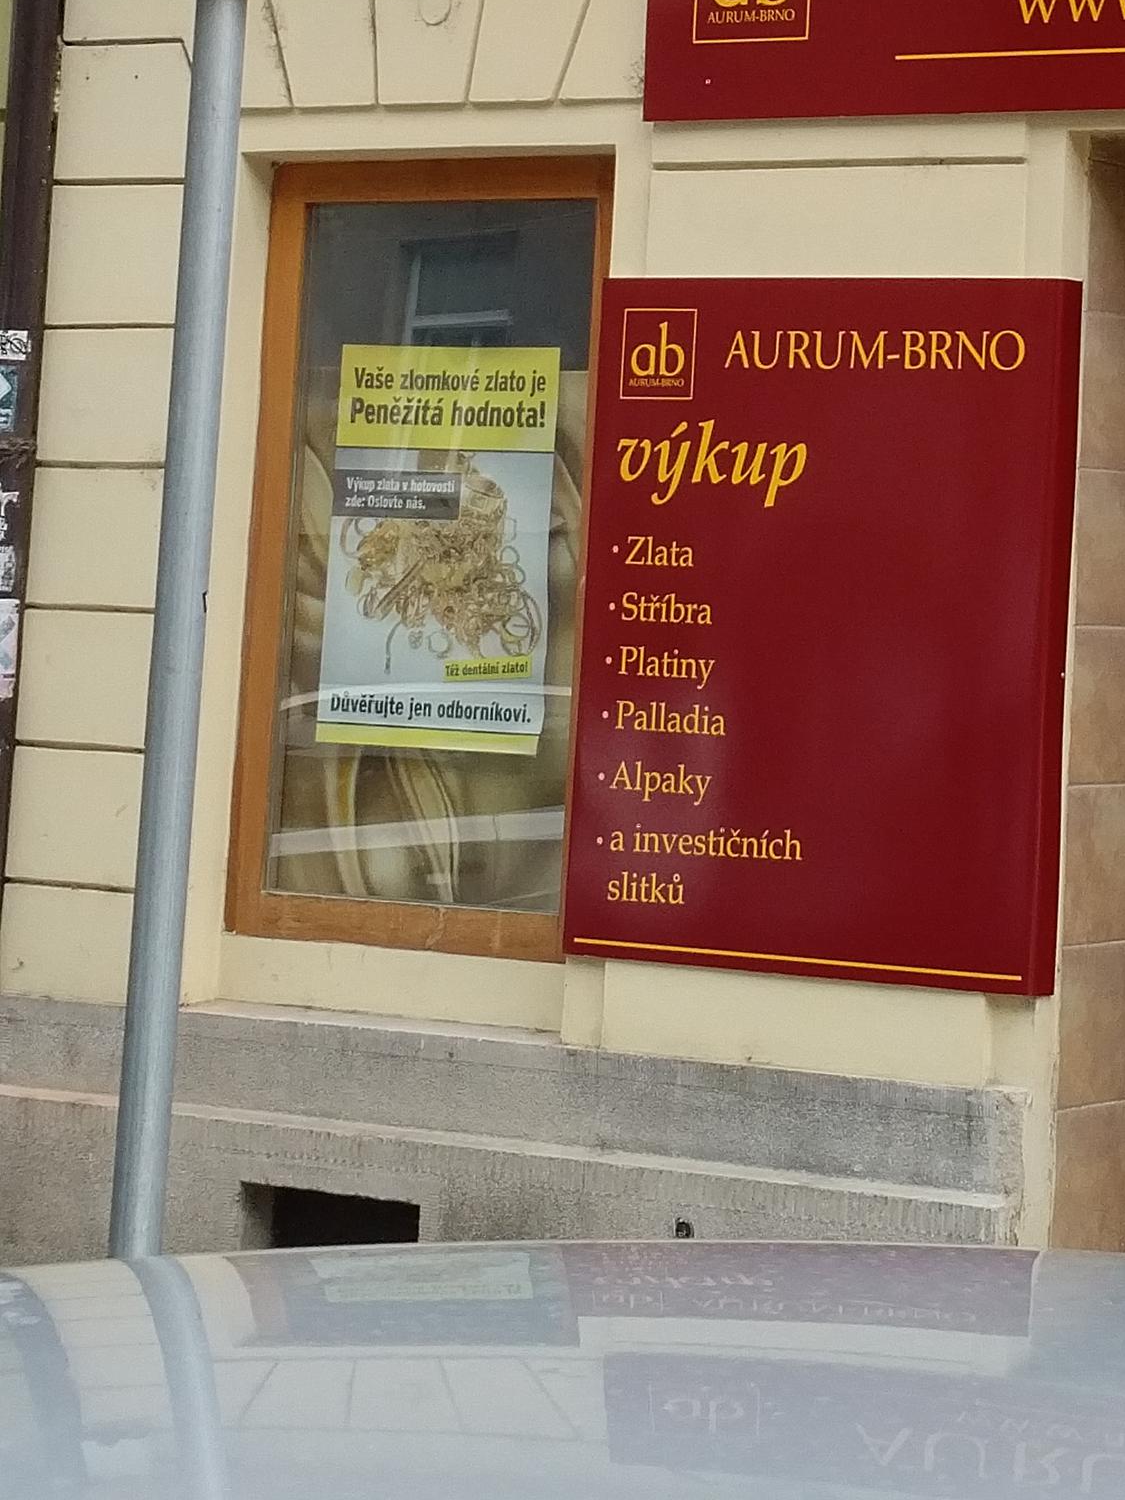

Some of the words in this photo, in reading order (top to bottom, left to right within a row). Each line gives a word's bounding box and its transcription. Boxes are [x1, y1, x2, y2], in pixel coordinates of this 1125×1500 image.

[708, 9, 795, 24] AURUM-BRNO
[631, 322, 684, 376] ab
[725, 330, 1025, 370] AURUM-BRNO
[354, 366, 395, 389] Vaše
[400, 368, 480, 392] zlomkové
[485, 370, 526, 393] zlato
[530, 372, 546, 397] je
[350, 398, 443, 426] Peněžitá
[450, 398, 546, 428] hodnota!
[617, 420, 807, 508] výkup
[625, 536, 693, 566] Zlata
[622, 592, 712, 624] Stříbra
[618, 646, 715, 689] Platiny
[330, 692, 404, 716] Důvěřujte
[408, 698, 432, 720] jen
[437, 698, 532, 724] odborníkovi.
[615, 700, 725, 735] Palladia
[609, 761, 712, 806] Alpaky
[610, 831, 624, 851] a
[633, 823, 802, 860] investičních
[607, 871, 684, 904] slitků
